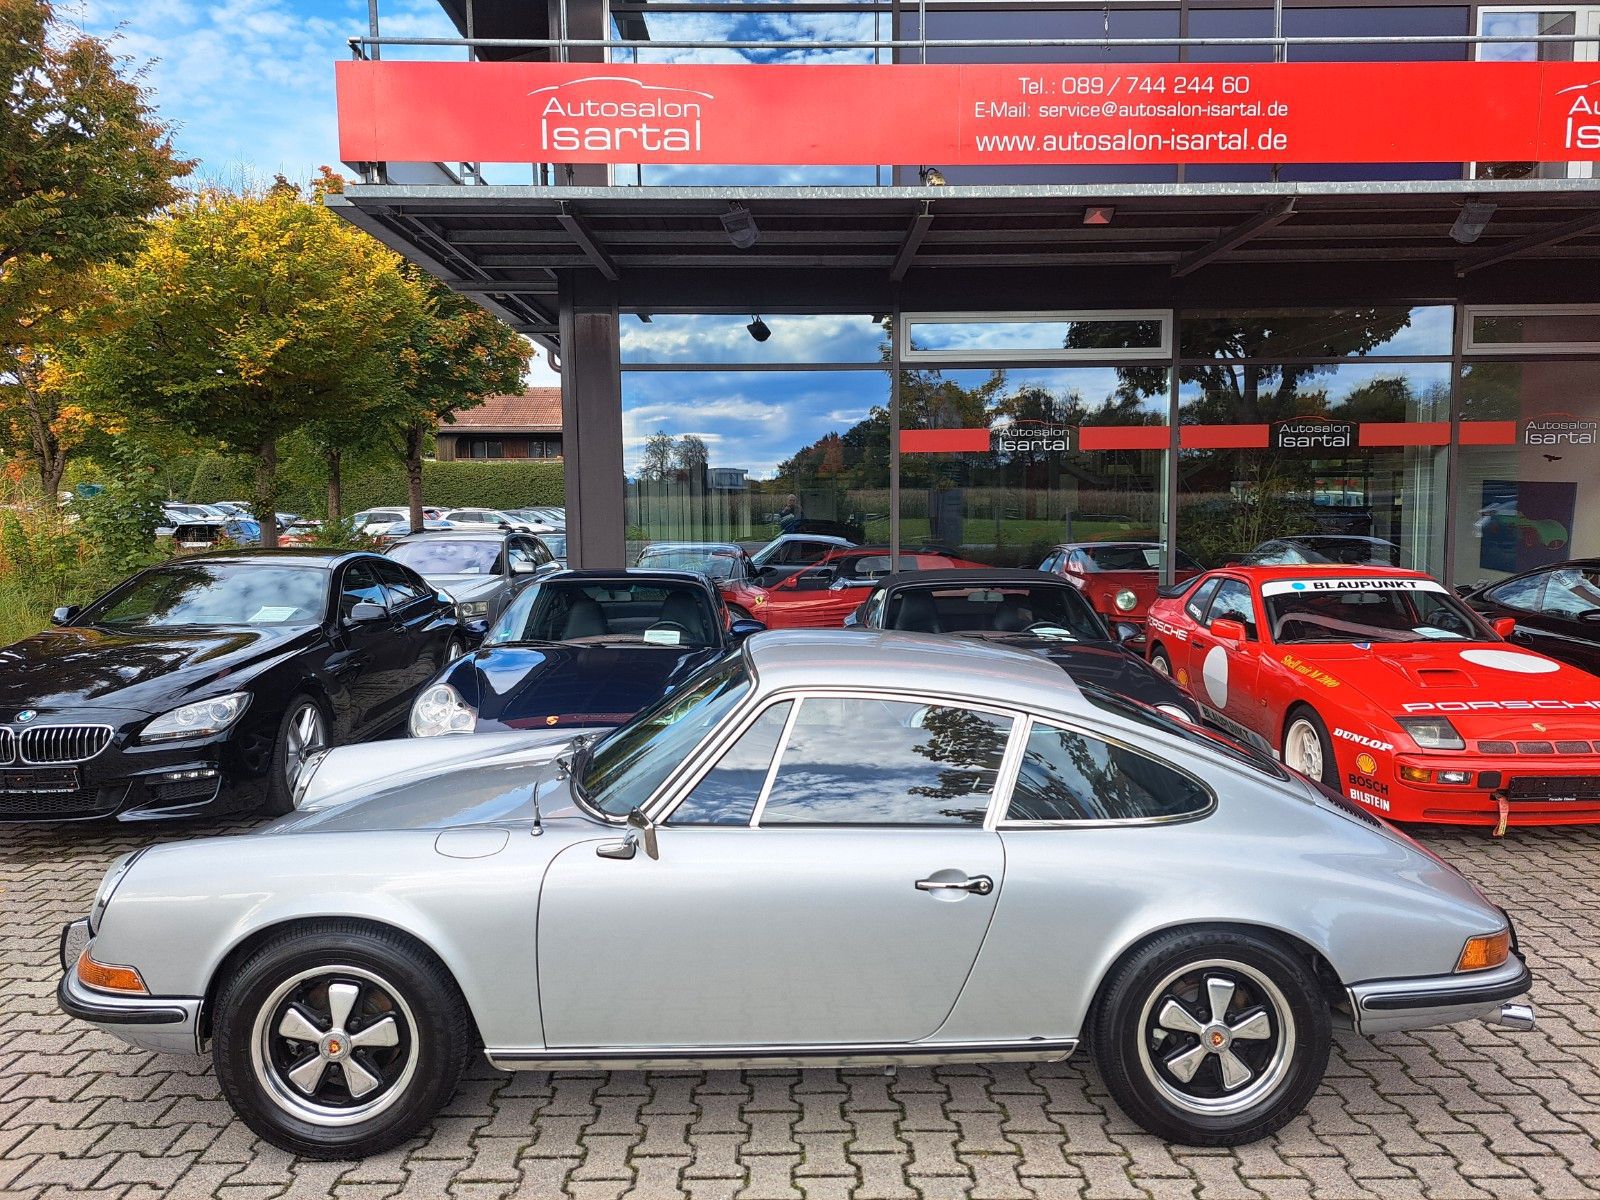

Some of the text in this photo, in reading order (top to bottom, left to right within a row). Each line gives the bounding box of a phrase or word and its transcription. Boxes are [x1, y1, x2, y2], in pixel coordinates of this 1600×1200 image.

[1018, 77, 1249, 96] Tel.: 089 / 744 244 60
[542, 97, 700, 118] Autosalon
[975, 101, 1288, 118] E-Mail: service@autosalon-isartal.de
[541, 118, 700, 151] Isartal
[975, 128, 1288, 151] www.autosalon-isartal.de
[1000, 427, 1070, 437] Autosalon
[1279, 423, 1350, 433] Autosalon
[1526, 420, 1597, 430] Autosalon
[999, 436, 1069, 451] Isartal
[1278, 433, 1350, 448] Isartal
[1525, 429, 1597, 444] Isartal
[1313, 580, 1417, 590] BLAUPUNKT
[1280, 654, 1303, 670] Shell
[1401, 700, 1600, 713] PORSCH
[1333, 727, 1394, 751] DUNLOP
[1348, 773, 1389, 796] BOSCH
[1349, 788, 1390, 812] BILSTEIN
